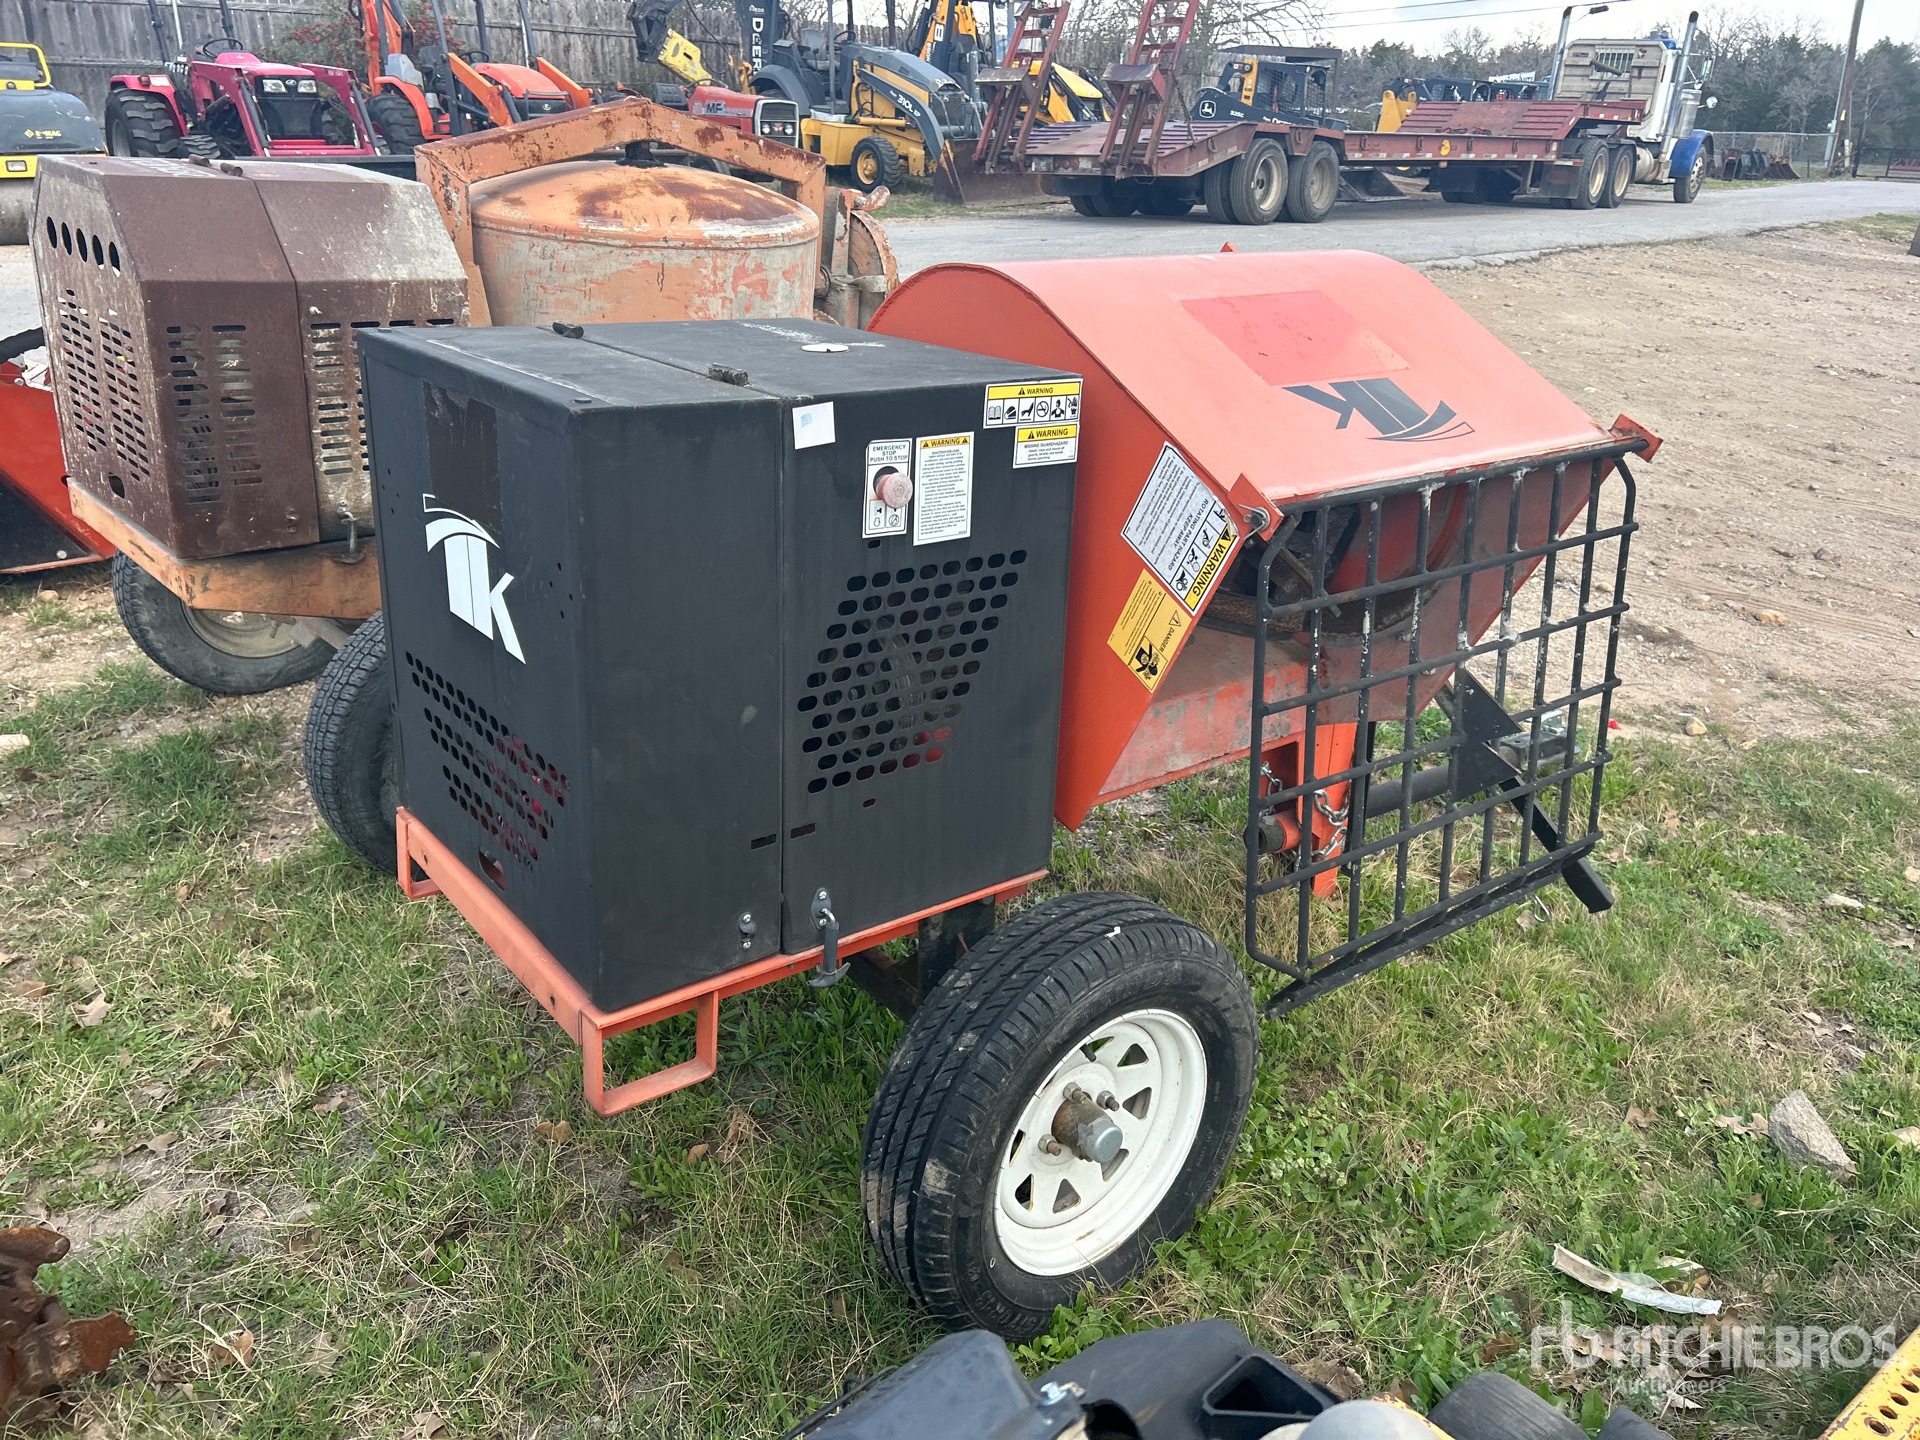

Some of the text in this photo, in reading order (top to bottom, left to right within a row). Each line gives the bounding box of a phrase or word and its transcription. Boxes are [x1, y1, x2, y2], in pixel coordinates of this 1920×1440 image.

[752, 17, 764, 75] DEER
[706, 102, 723, 114] MF
[897, 94, 914, 113] 310L
[1026, 387, 1054, 395] WARNING
[930, 437, 962, 447] WARNING
[1036, 428, 1068, 438] WARNING
[1166, 496, 1209, 572] ROTATING PART HAZARD
[1172, 511, 1193, 549] KEEP AWAY
[1191, 540, 1226, 598] WARNING
[1159, 625, 1175, 653] DANGER
